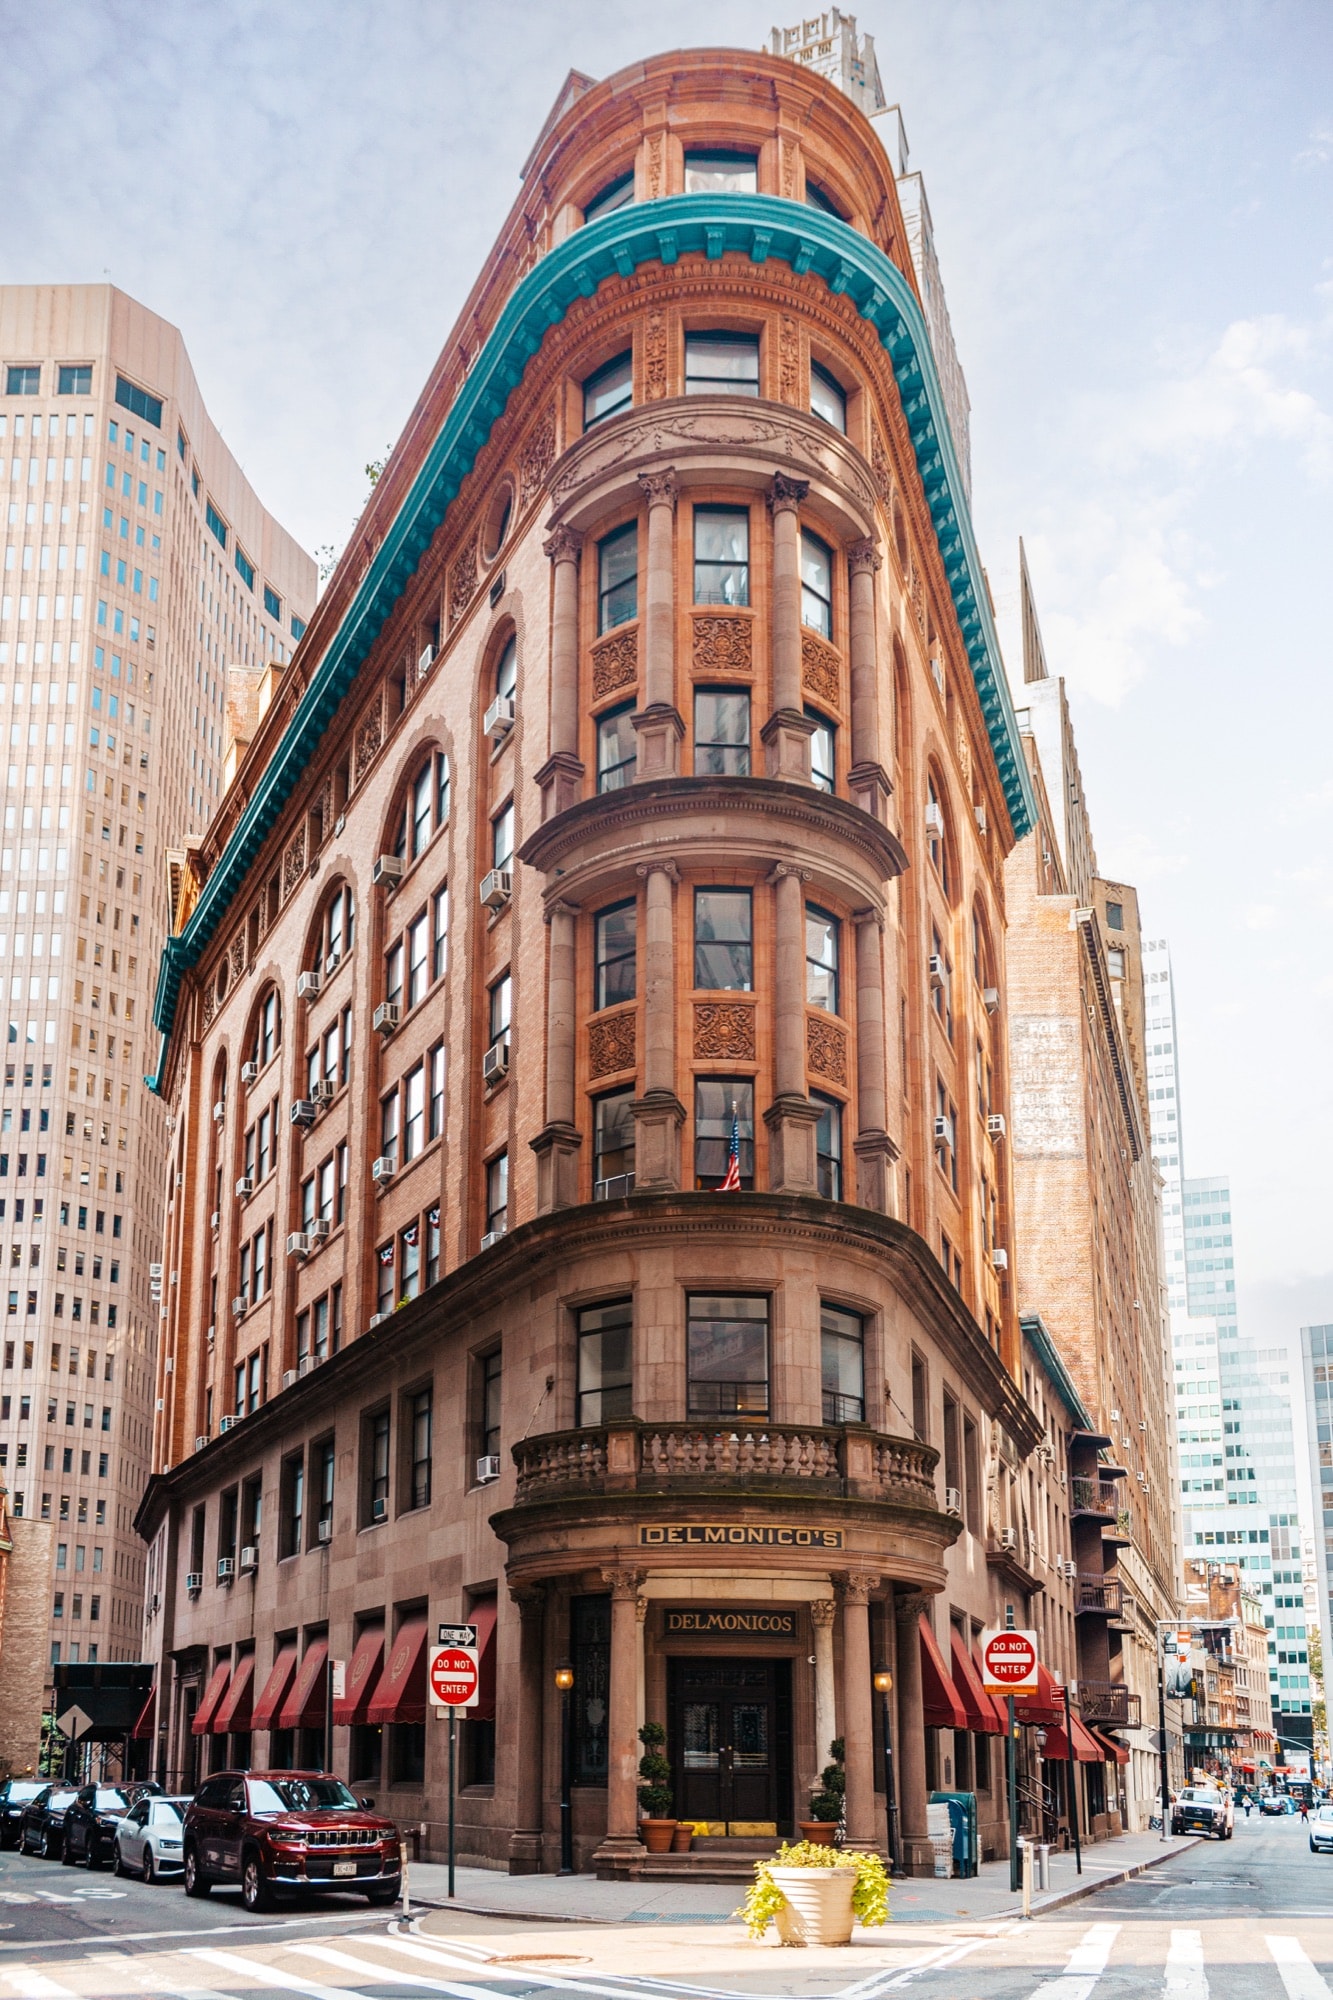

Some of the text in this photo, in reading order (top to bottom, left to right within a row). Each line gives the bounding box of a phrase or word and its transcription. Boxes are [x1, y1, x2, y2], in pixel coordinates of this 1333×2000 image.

[646, 1527, 838, 1546] DELMONICO'S
[669, 1614, 792, 1632] DELMONICOS
[443, 1630, 471, 1640] ONE WAY
[993, 1642, 1027, 1651] DO NOT
[437, 1659, 471, 1670] DO NOT
[994, 1665, 1027, 1674] ENTER
[440, 1684, 468, 1694] ENTER
